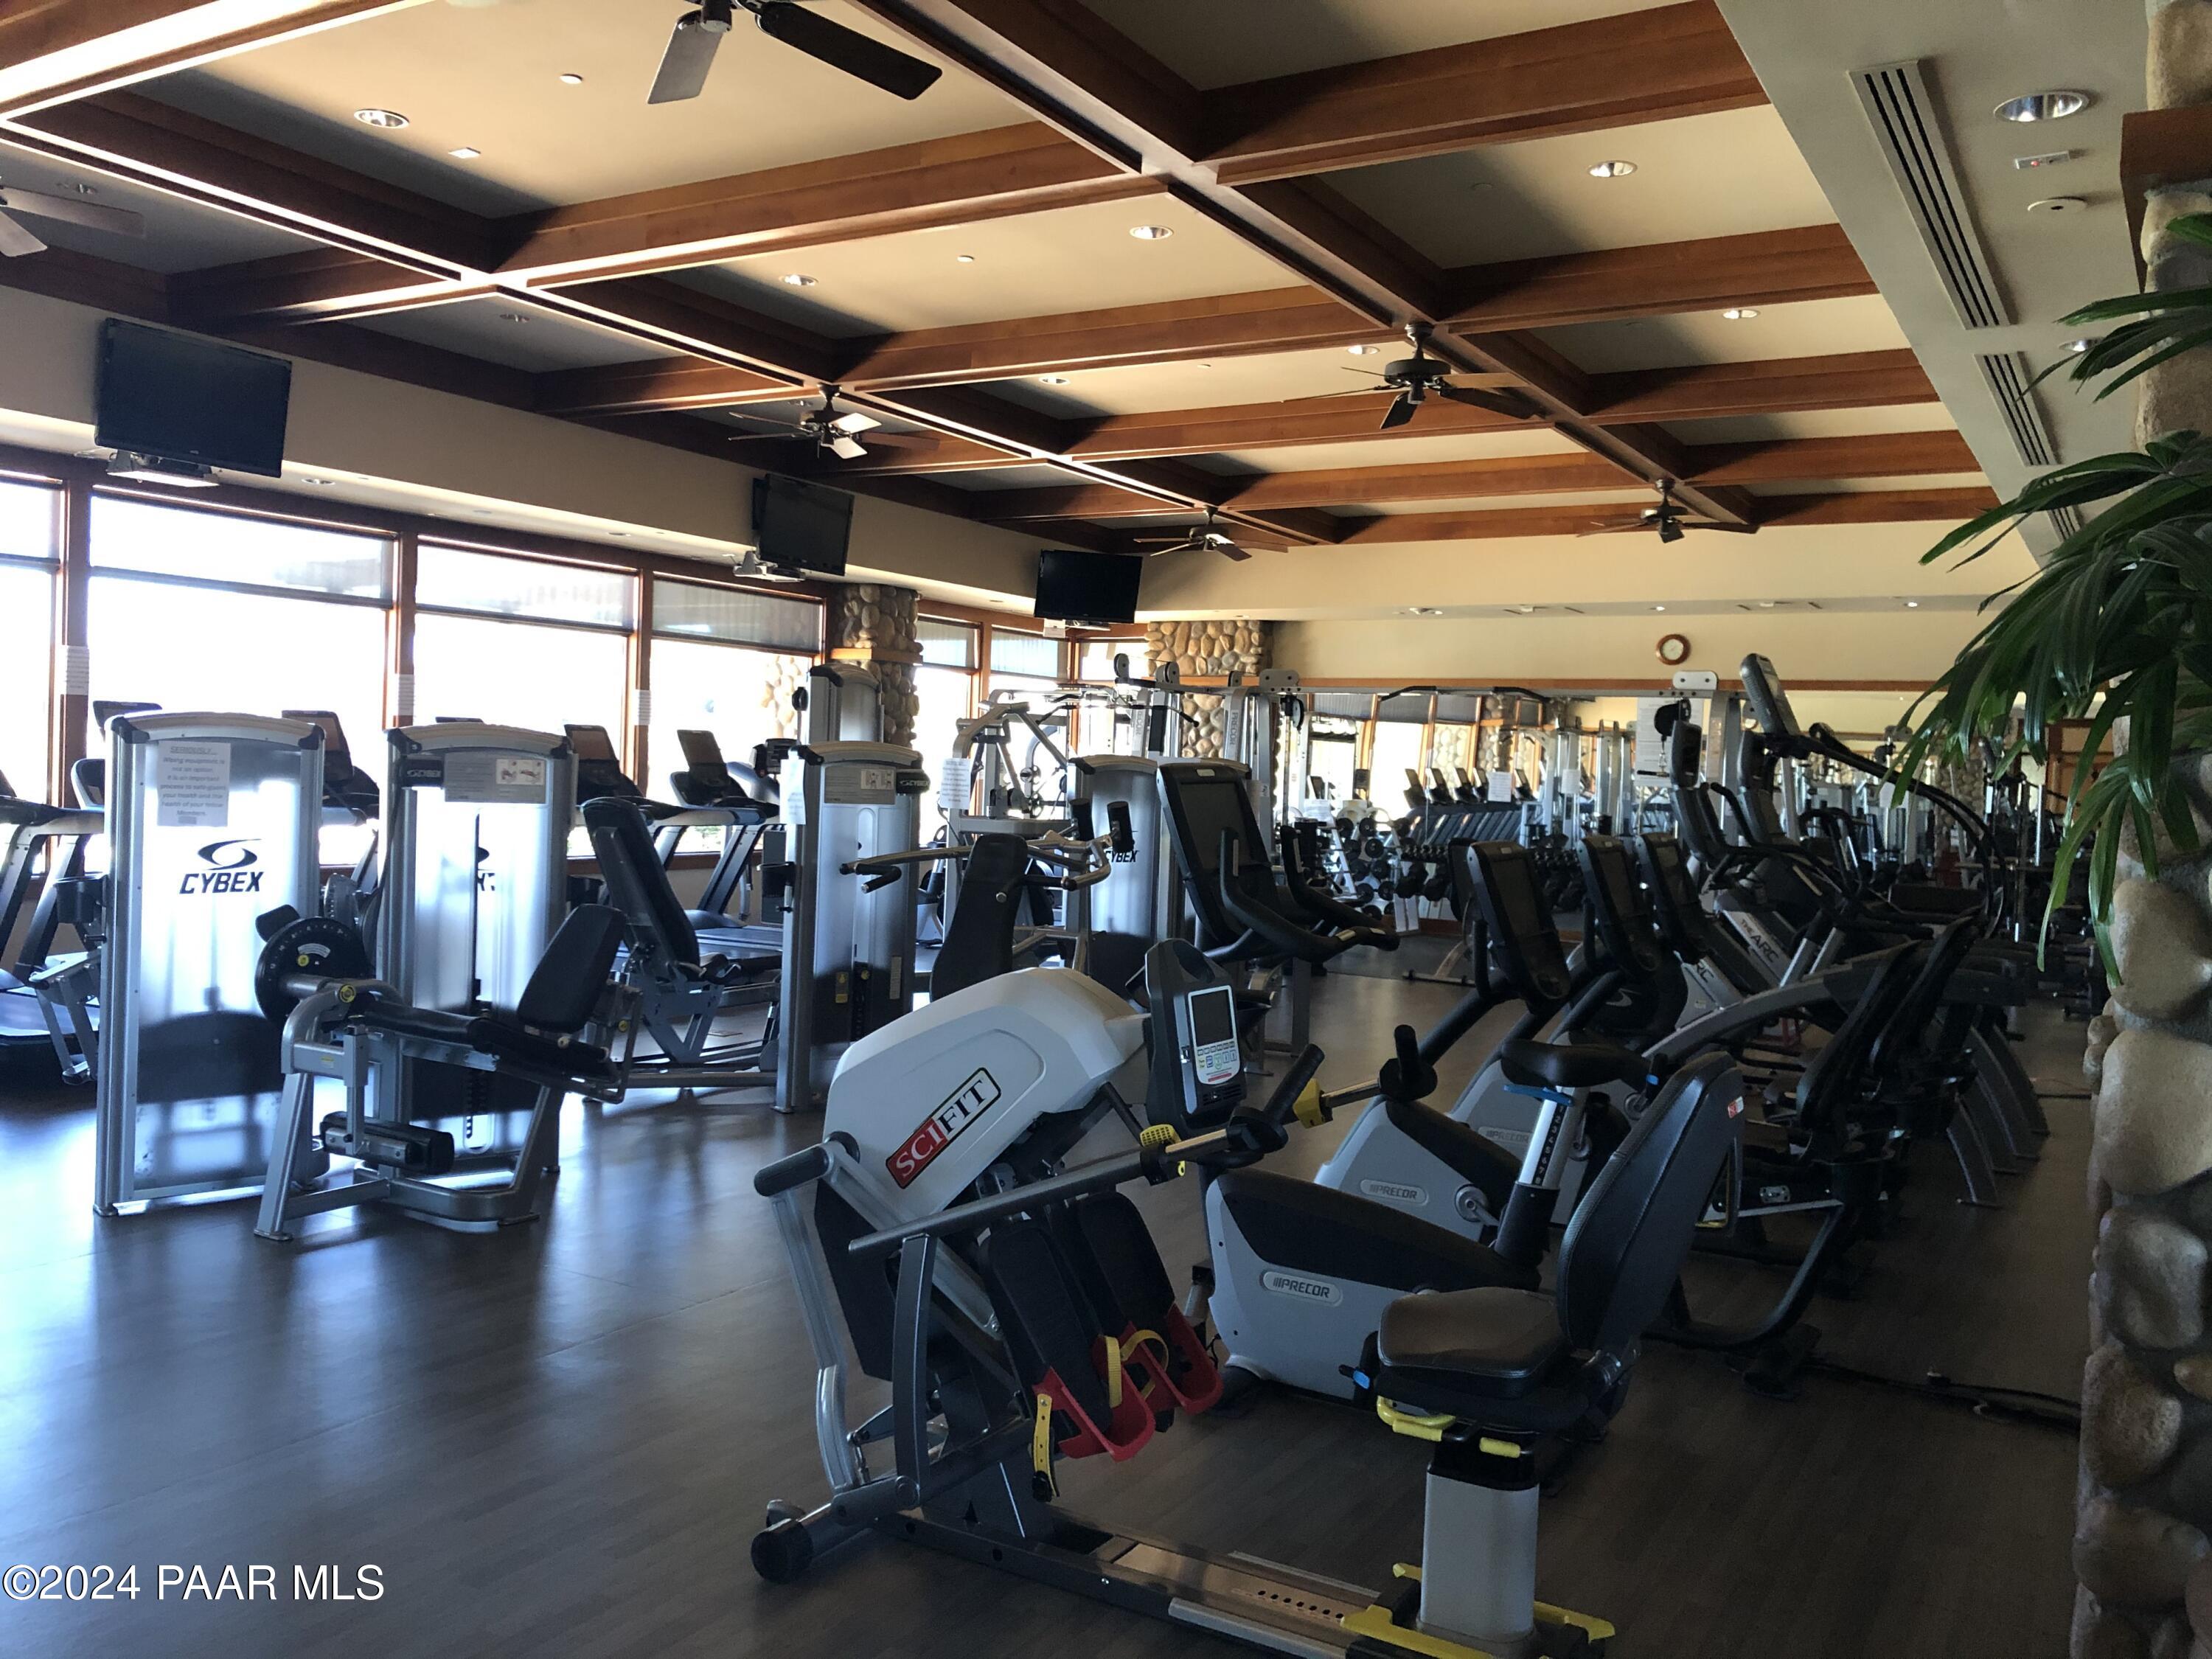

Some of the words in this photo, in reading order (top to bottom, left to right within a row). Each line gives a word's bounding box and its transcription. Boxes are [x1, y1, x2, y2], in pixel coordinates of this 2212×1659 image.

[179, 872, 264, 894] CYBEX
[1750, 934, 1779, 963] ARC
[896, 1079, 986, 1177] SCIFIT
[1376, 1184, 1417, 1199] PRECOR
[1281, 1278, 1330, 1298] PRECOR
